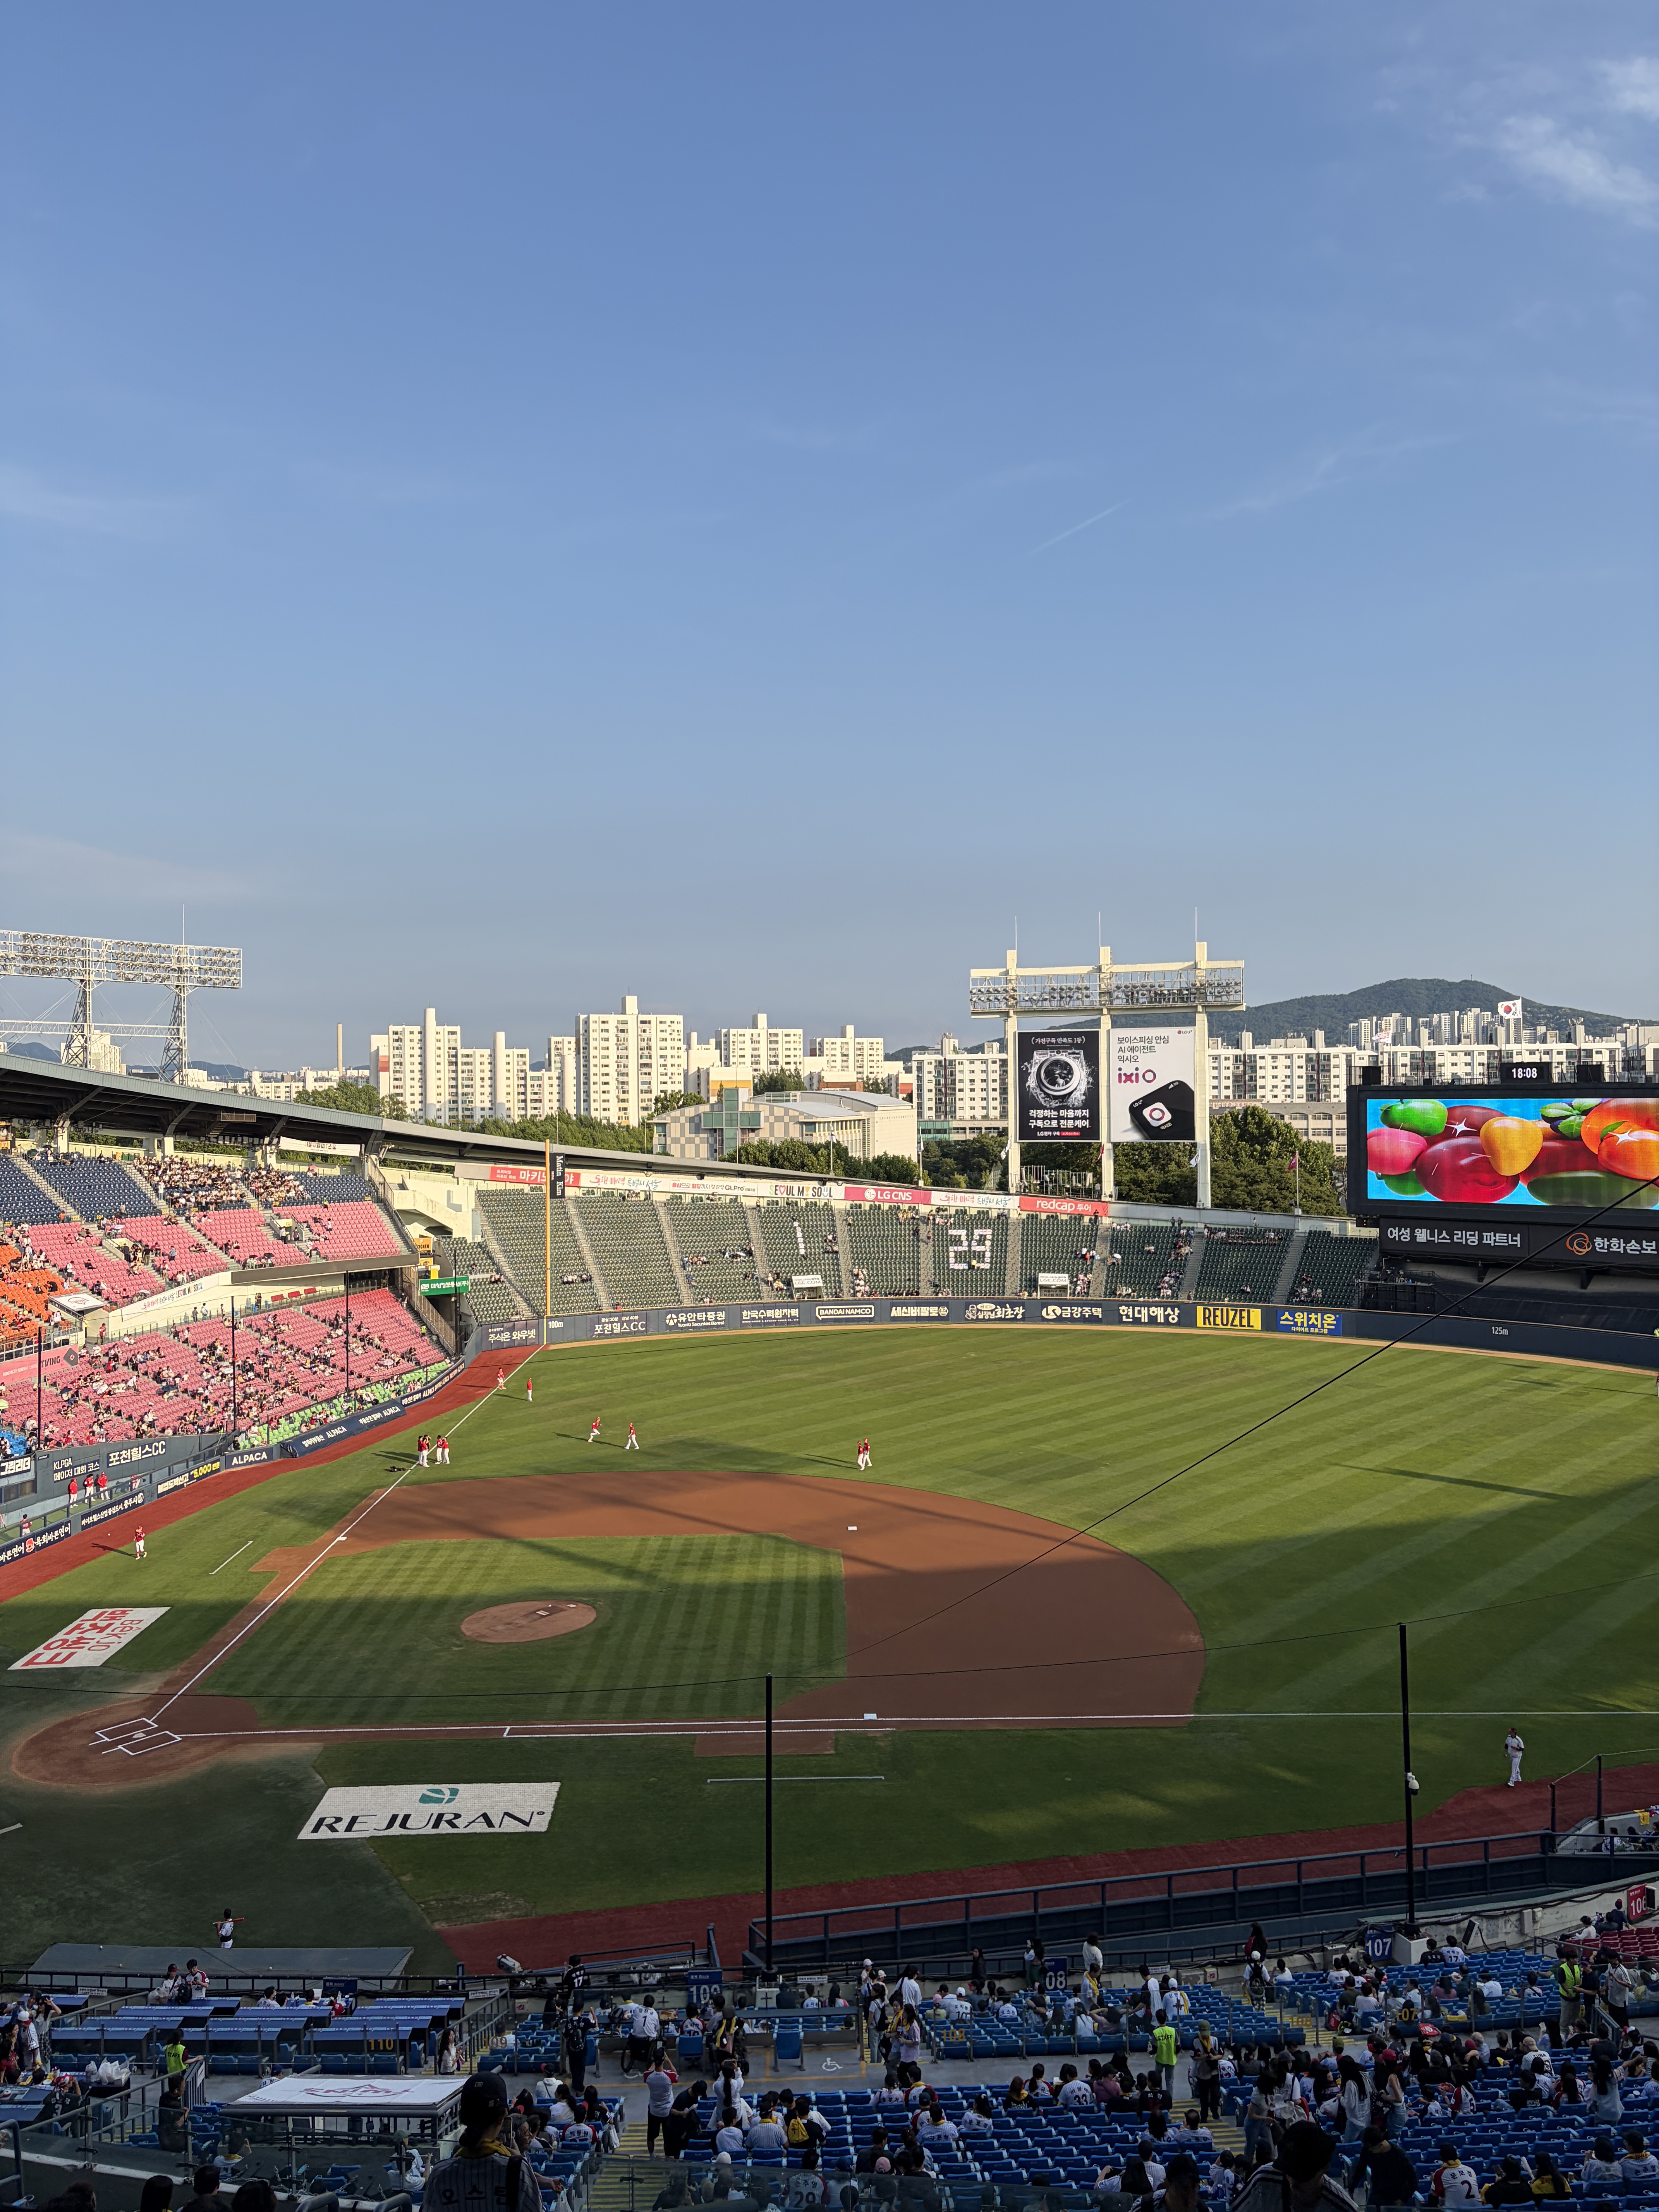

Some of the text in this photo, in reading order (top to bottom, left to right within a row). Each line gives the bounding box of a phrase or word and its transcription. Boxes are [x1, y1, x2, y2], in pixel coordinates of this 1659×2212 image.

[1117, 1035, 1169, 1044] 보이스피싱 안심
[1127, 1046, 1156, 1054] 에이전트
[1118, 1055, 1139, 1063] 익시오
[1511, 1067, 1537, 1079] 18:08
[1029, 1109, 1089, 1118] 걱정하는 마음까지
[1029, 1120, 1058, 1128] 구독으로
[646, 1180, 661, 1190] 서울
[878, 1190, 912, 1200] LG CNS
[995, 1197, 1011, 1207] 서울
[1036, 1199, 1092, 1213] redcap 투어
[1387, 1227, 1521, 1248] 여성 웰니스 리딩 파트너
[1594, 1237, 1658, 1254] 한화손보
[678, 1311, 725, 1322] 유안타증권
[742, 1308, 799, 1320] 한국수력원자력
[1061, 1306, 1102, 1319] 금강주택
[1119, 1305, 1180, 1323] 현대해상
[1202, 1307, 1254, 1328] REUZEL
[548, 1321, 563, 1329] 100m
[1279, 1312, 1337, 1329] 스위치온
[594, 1321, 646, 1334] 포천힐스CC
[1491, 1326, 1508, 1336] 125m
[488, 1329, 536, 1343] 주식은 와우넷
[382, 1406, 401, 1417] ALPACA
[326, 1426, 347, 1439] ALPACA
[108, 1441, 166, 1466] 포천힐스CC
[232, 1451, 267, 1466] ALPACA
[53, 1458, 72, 1470] KLPGA
[53, 1461, 100, 1481] 메이저 대회 코스
[124, 1496, 137, 1509] 충주시
[310, 1810, 534, 1834] REJURAN
[1631, 1897, 1647, 1916] 106
[1366, 1937, 1392, 1957] 107
[574, 1976, 583, 1988] 17
[1046, 1970, 1066, 1990] 08
[642, 2015, 647, 2027] 1
[1396, 2008, 1417, 2022] 107
[941, 2028, 965, 2042] 108
[368, 2039, 394, 2051] 110
[484, 2037, 507, 2049] 109
[1461, 2180, 1475, 2200] 2
